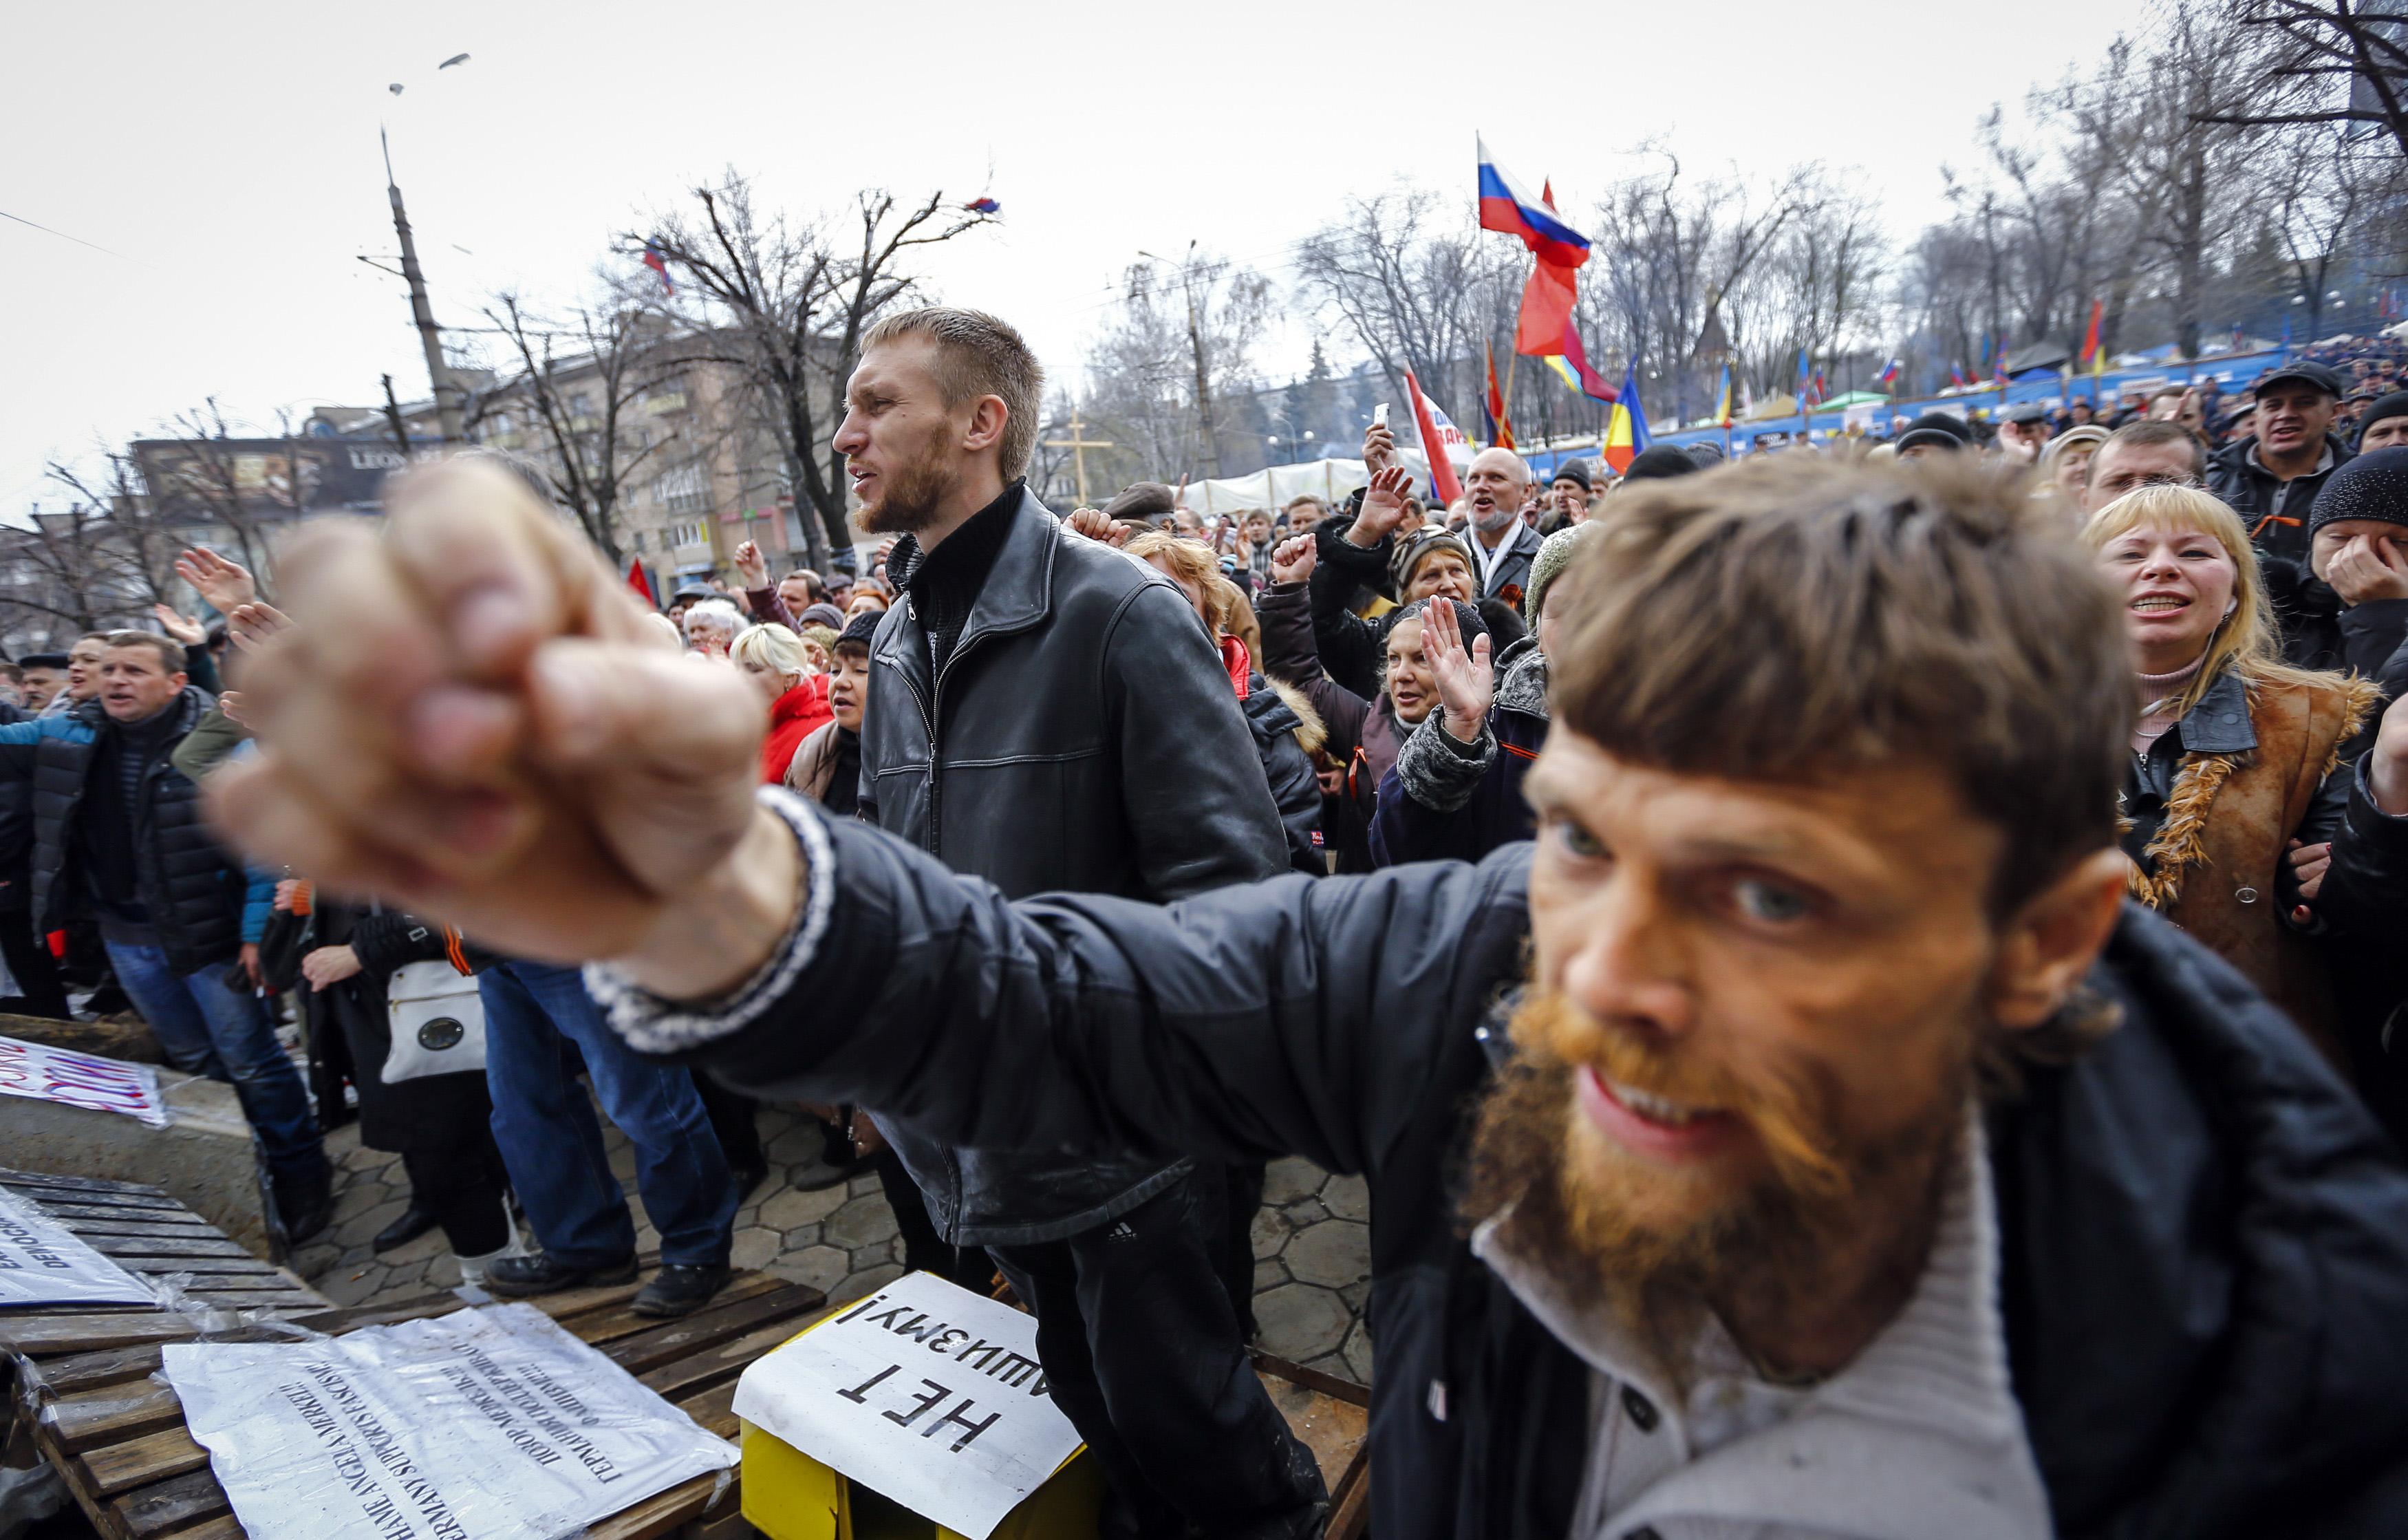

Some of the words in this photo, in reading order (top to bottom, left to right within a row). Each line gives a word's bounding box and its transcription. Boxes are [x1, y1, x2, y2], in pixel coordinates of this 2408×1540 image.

[835, 1294, 1051, 1397] АШИЗМУ!
[278, 1381, 342, 1439] MERKEL!!
[304, 1360, 367, 1415] FASCISM!!
[836, 1364, 1002, 1453] НЕТ
[325, 1434, 383, 1497] ANGELA
[350, 1412, 418, 1477] SUPPORTS
[506, 1429, 561, 1466] ПОЗОР
[537, 1415, 623, 1484] ГЕРМАНИЯ
[362, 1494, 416, 1540] HAME
[399, 1477, 469, 1540] ERMANY
